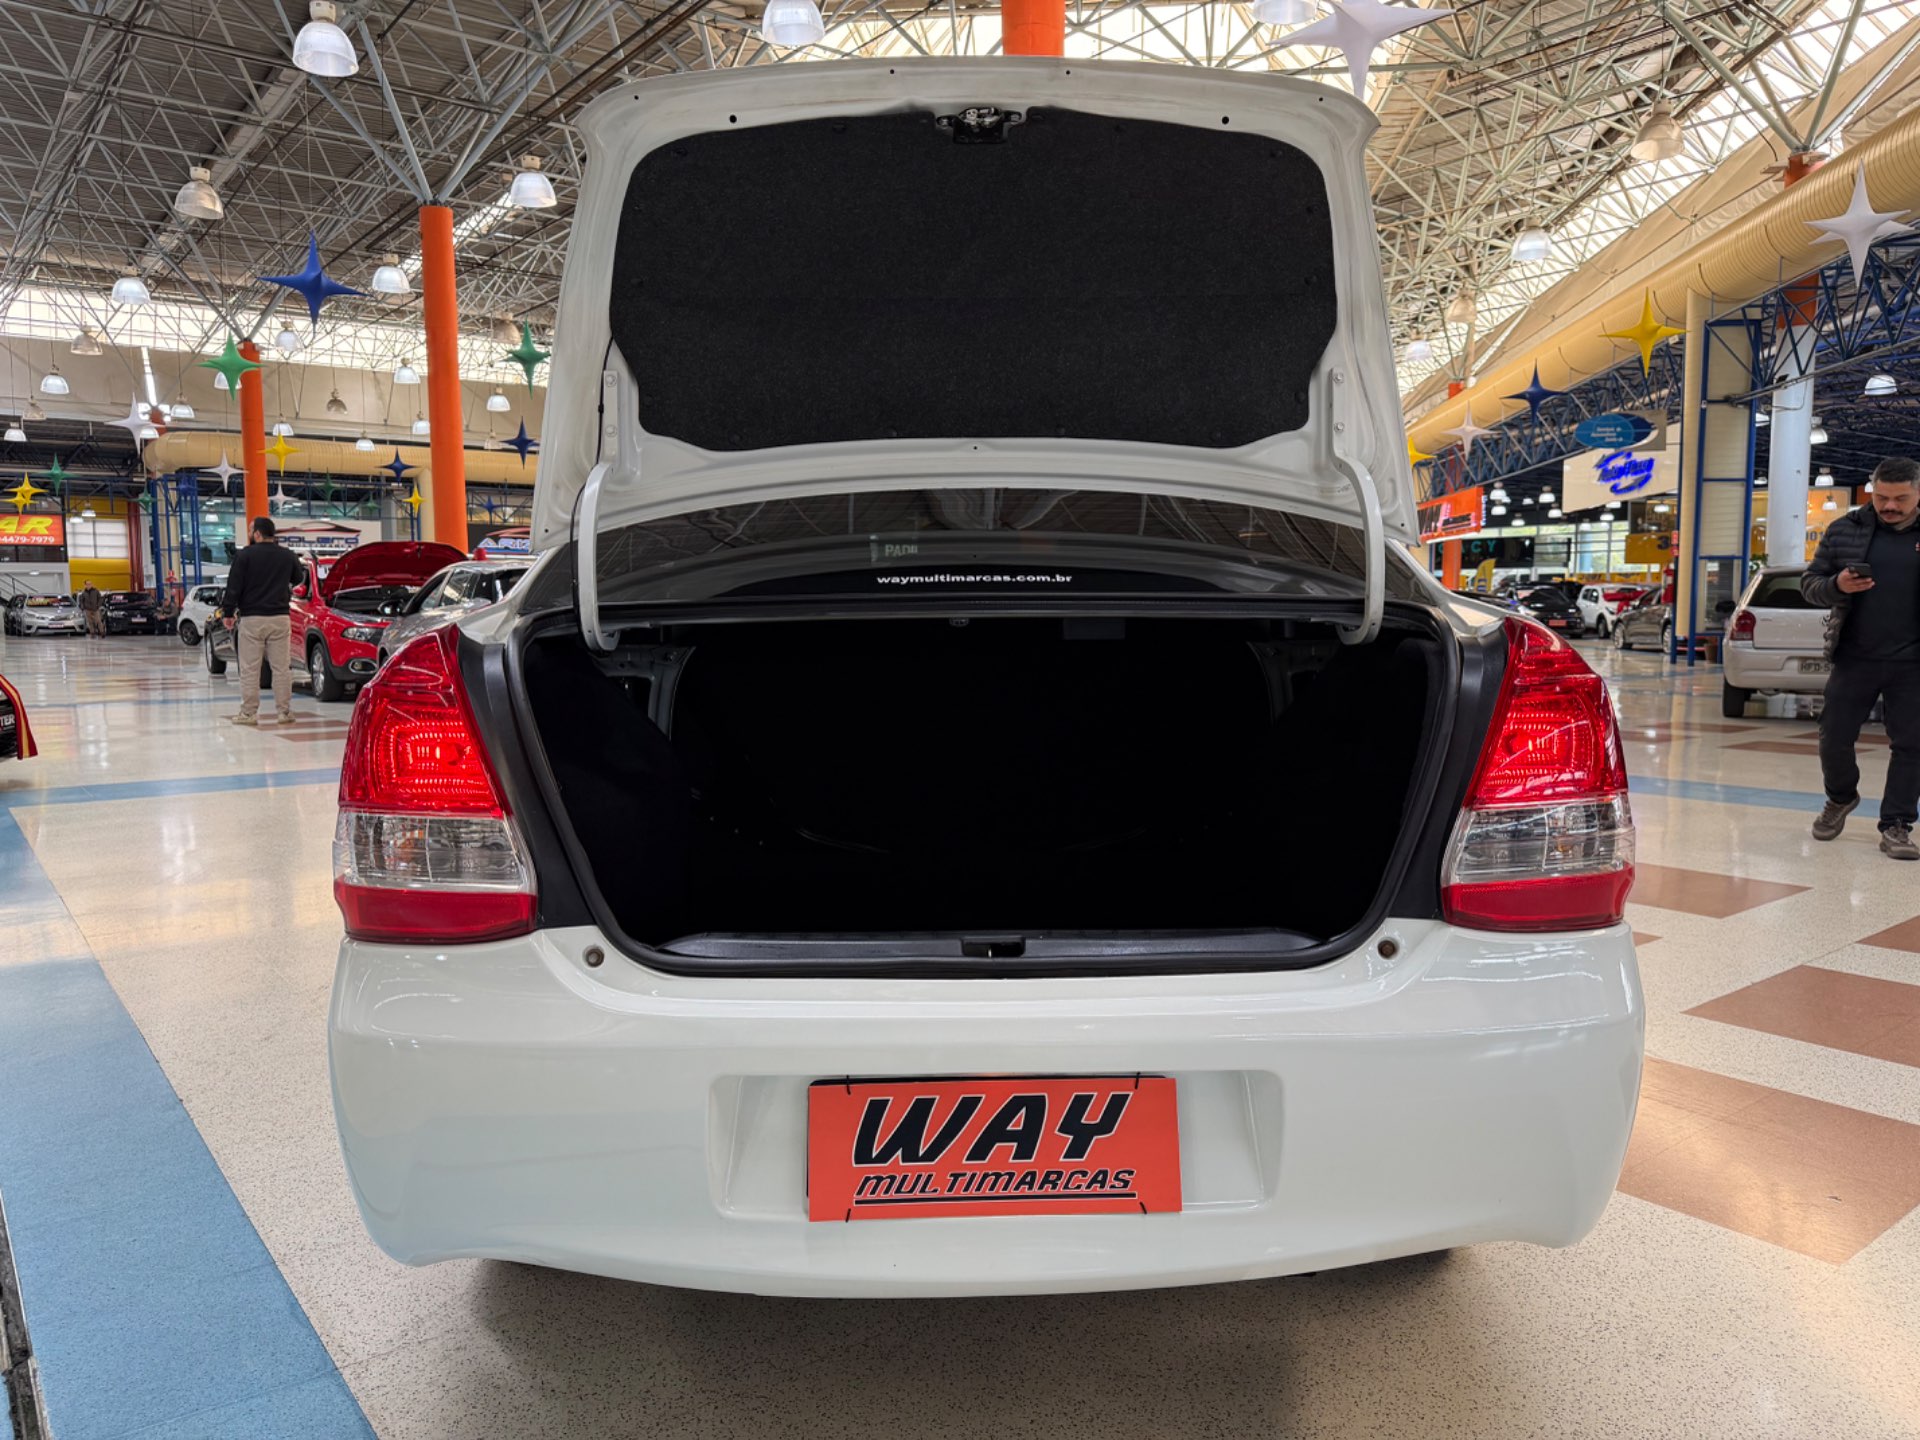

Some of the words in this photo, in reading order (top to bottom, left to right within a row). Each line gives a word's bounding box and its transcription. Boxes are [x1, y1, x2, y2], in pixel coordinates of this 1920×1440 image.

[877, 574, 1073, 585] waymultimarcas.com.br
[853, 1092, 1134, 1167] WAY
[855, 1168, 1137, 1197] MULTIMARCAS
